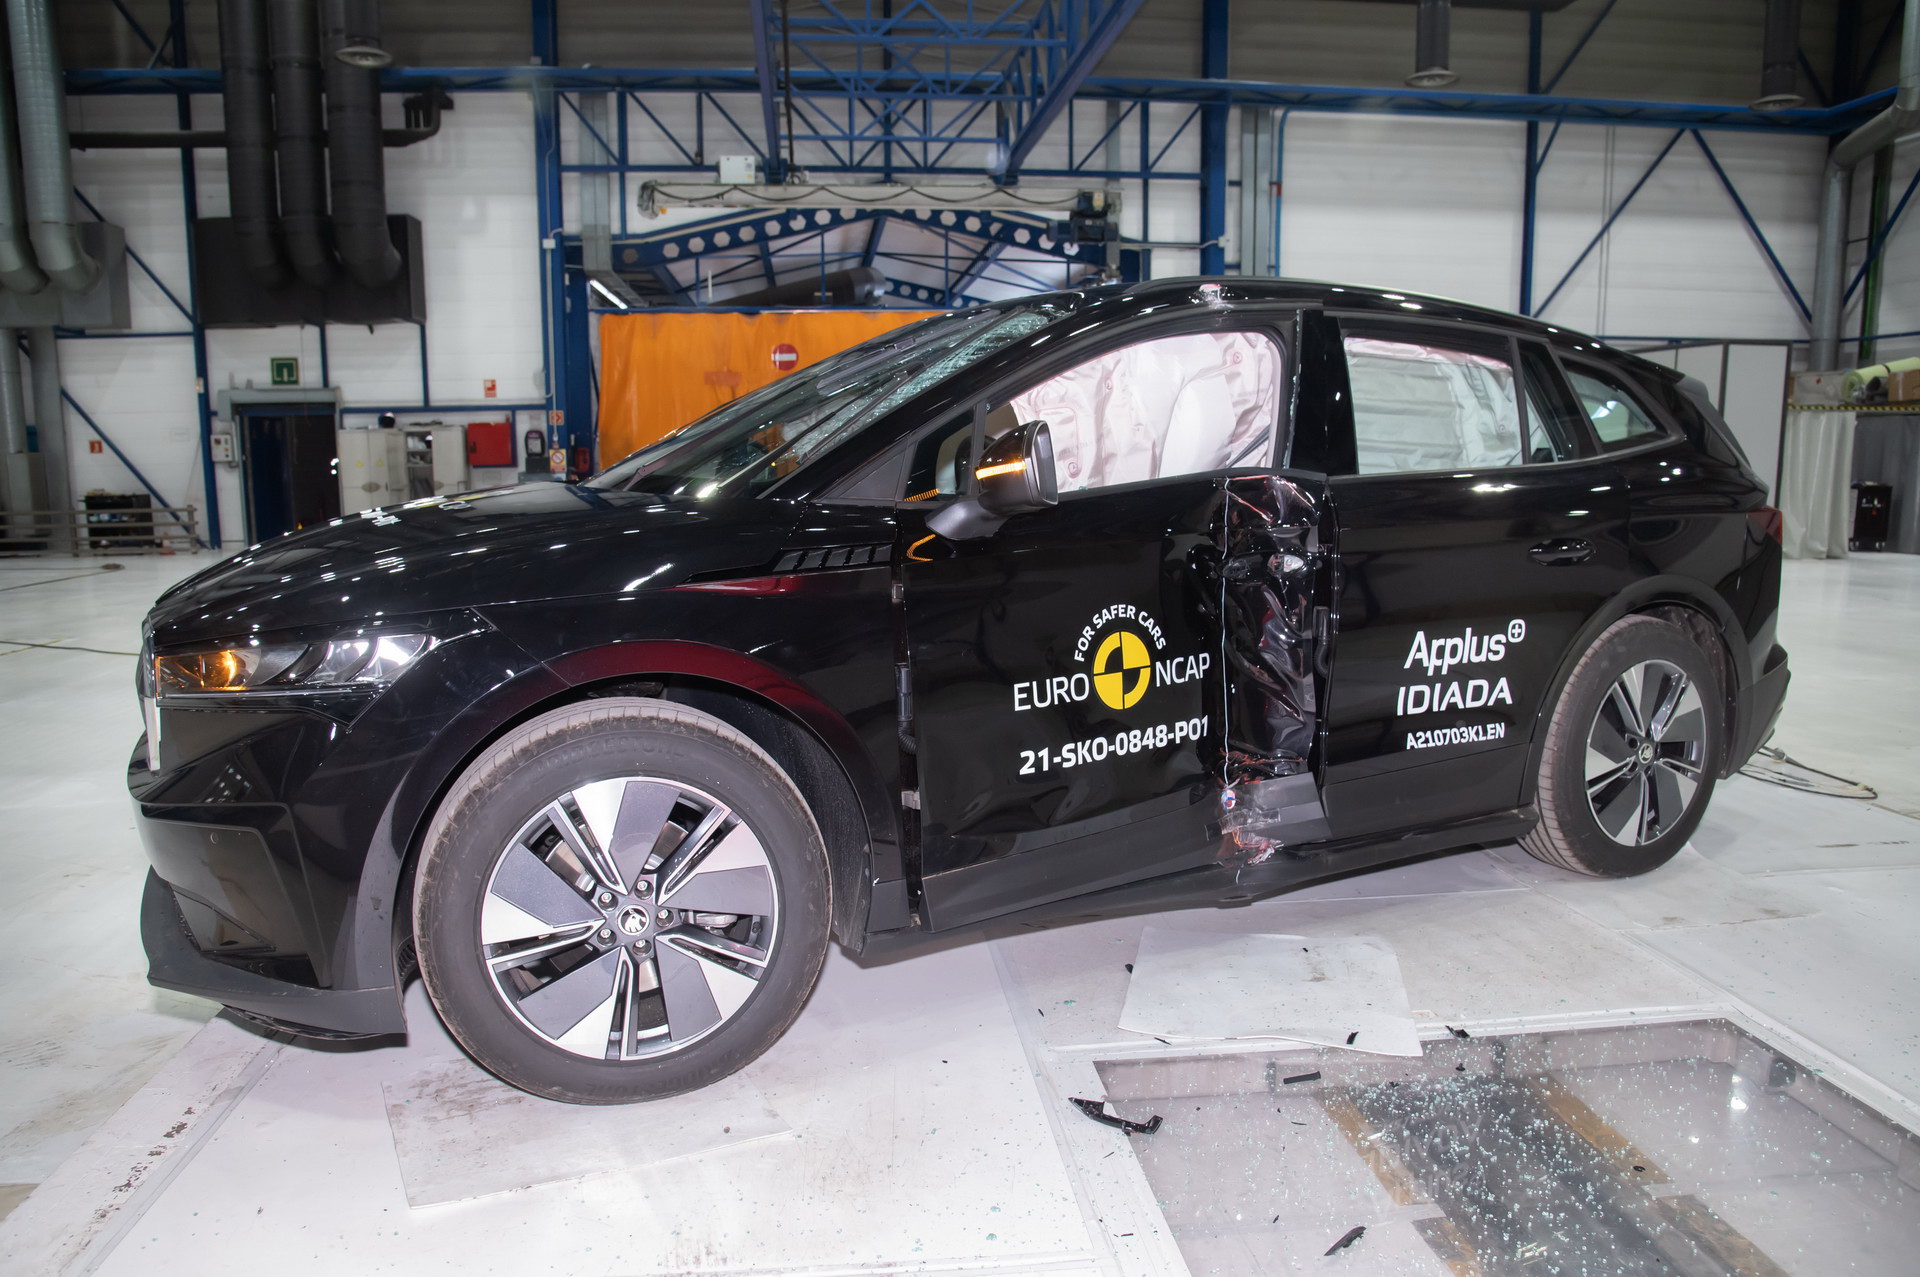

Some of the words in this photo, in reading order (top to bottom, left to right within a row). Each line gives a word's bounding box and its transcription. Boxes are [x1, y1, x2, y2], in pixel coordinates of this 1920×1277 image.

[1074, 626, 1095, 662] FOR
[1093, 604, 1136, 629] SAFER
[1138, 611, 1166, 650] CARS
[1013, 673, 1090, 711] EURO
[1155, 652, 1210, 687] NCAP
[1397, 677, 1513, 716] IDIADA
[1406, 722, 1505, 750] A210703KLEN
